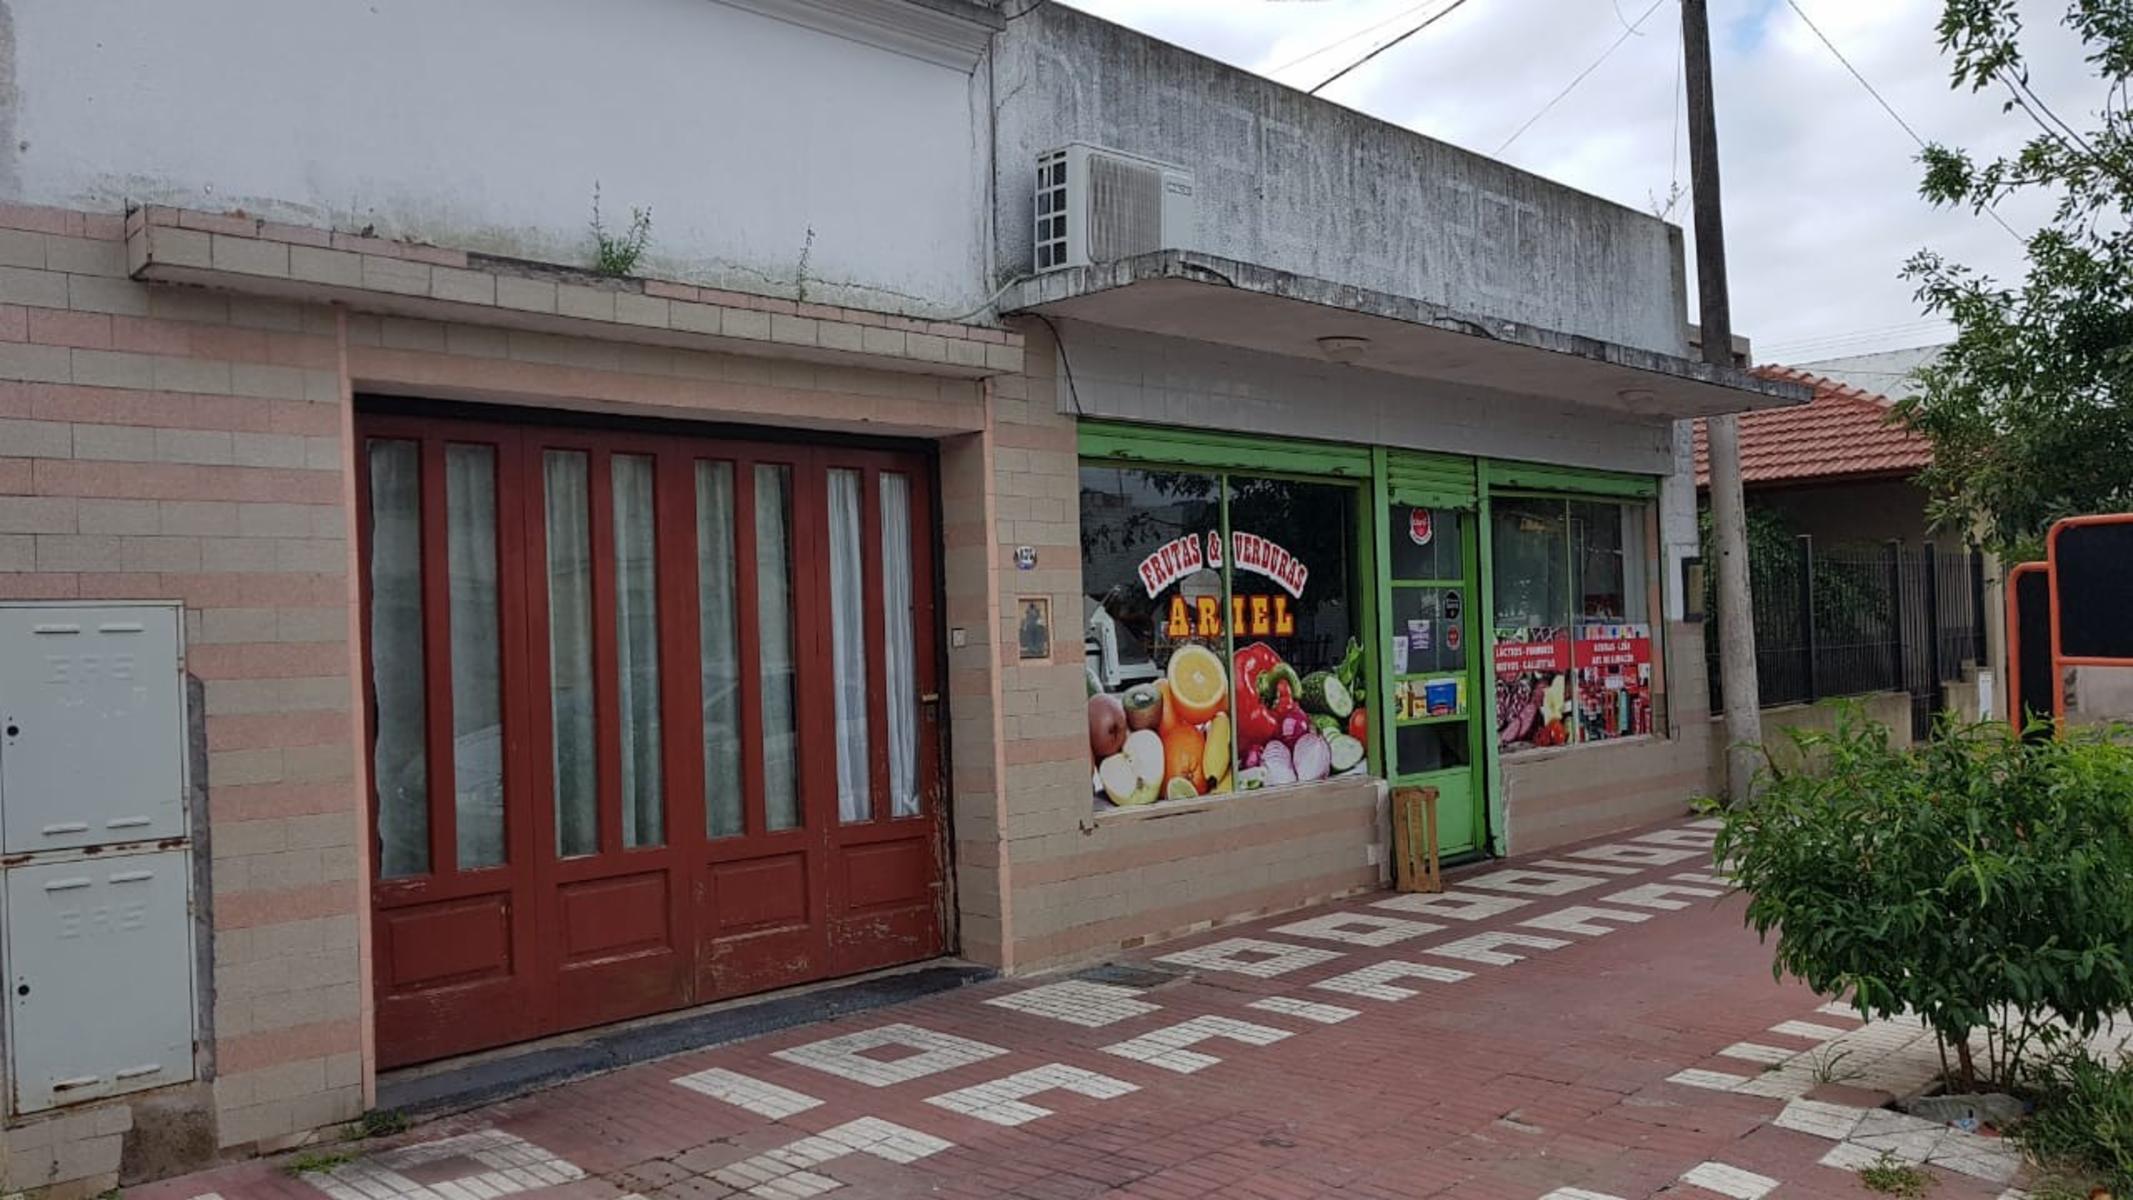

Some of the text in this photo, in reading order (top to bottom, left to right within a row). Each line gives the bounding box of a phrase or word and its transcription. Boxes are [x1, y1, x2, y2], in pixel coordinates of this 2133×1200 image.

[1140, 531, 1307, 595] FRUTAS & VERDURAS
[1168, 596, 1294, 637] ARIEL
